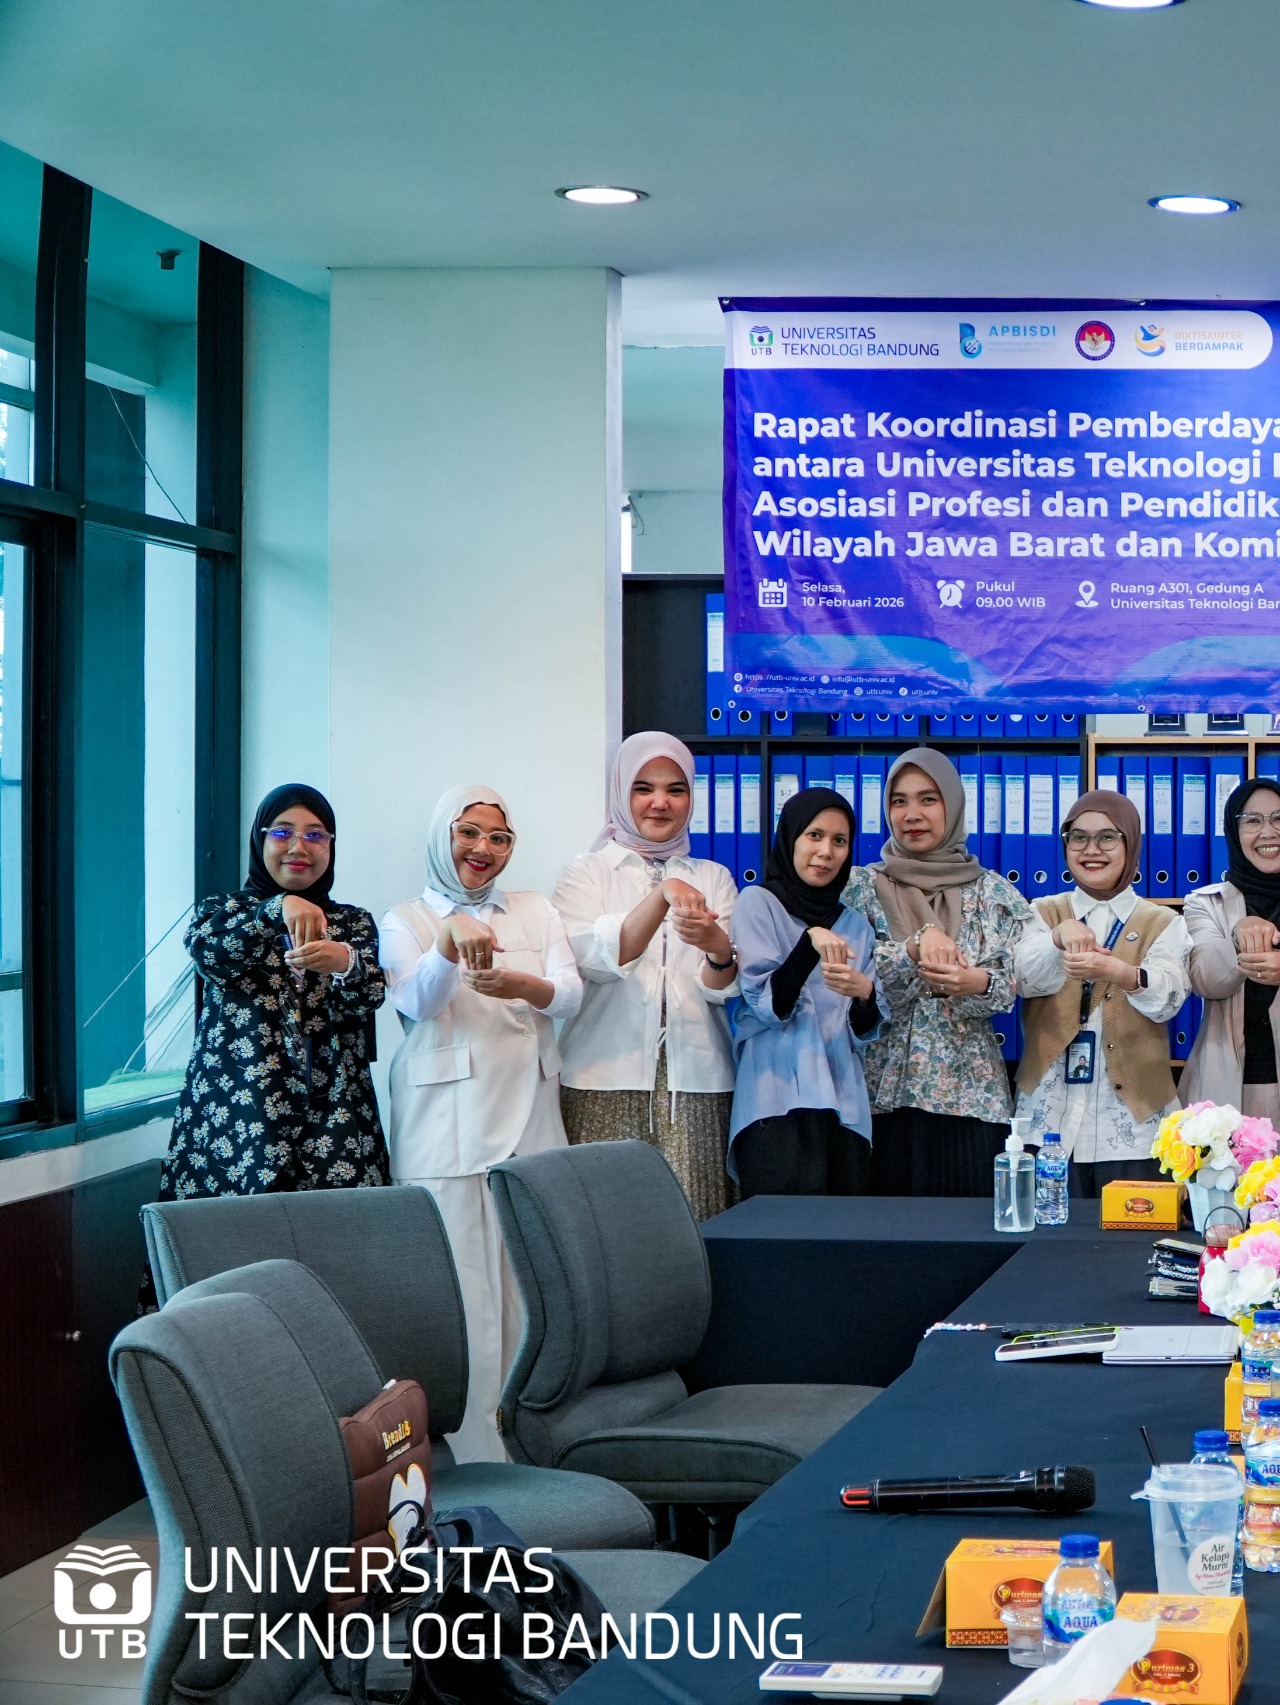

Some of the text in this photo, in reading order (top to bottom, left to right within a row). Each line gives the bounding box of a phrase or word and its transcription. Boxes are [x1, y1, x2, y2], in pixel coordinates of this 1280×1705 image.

[781, 327, 876, 339] UNIVERSITAS
[989, 325, 1057, 337] APBISDI
[1175, 331, 1244, 340] DIKTISAINTEK
[751, 347, 772, 356] UTB
[782, 343, 939, 356] TEKNOLOGI BANDUNG
[1175, 342, 1244, 351] BERDAMPAK
[754, 412, 855, 444] Rapat
[867, 409, 1057, 438] Koordinasi
[753, 453, 865, 478] antara
[876, 448, 1075, 478] Universitas
[1084, 448, 1262, 485] Teknologi
[752, 488, 897, 518] Asosiasi
[908, 488, 1031, 517] Profesi
[1041, 490, 1108, 518] dan
[753, 528, 896, 564] Wilayah
[905, 531, 998, 557] Jawa
[1009, 531, 1106, 558] Barat
[1115, 530, 1183, 558] dan
[802, 582, 845, 594] Selasa,
[976, 580, 1015, 592] Pukul
[1110, 582, 1264, 597] Ruang A301, Gedung A
[802, 597, 904, 607] 10 Februari 2026
[975, 596, 1046, 607] 09.00 WIB
[1110, 597, 1185, 610] Universitas
[1187, 597, 1254, 612] Teknologi
[746, 686, 784, 694] Universitas
[818, 688, 848, 696] Bandung
[1211, 1543, 1225, 1553] Air
[1201, 1552, 1230, 1563] Kelapa
[1201, 1561, 1229, 1572] Murni
[1063, 1616, 1098, 1630] AQUA
[1187, 1663, 1195, 1673] 3
